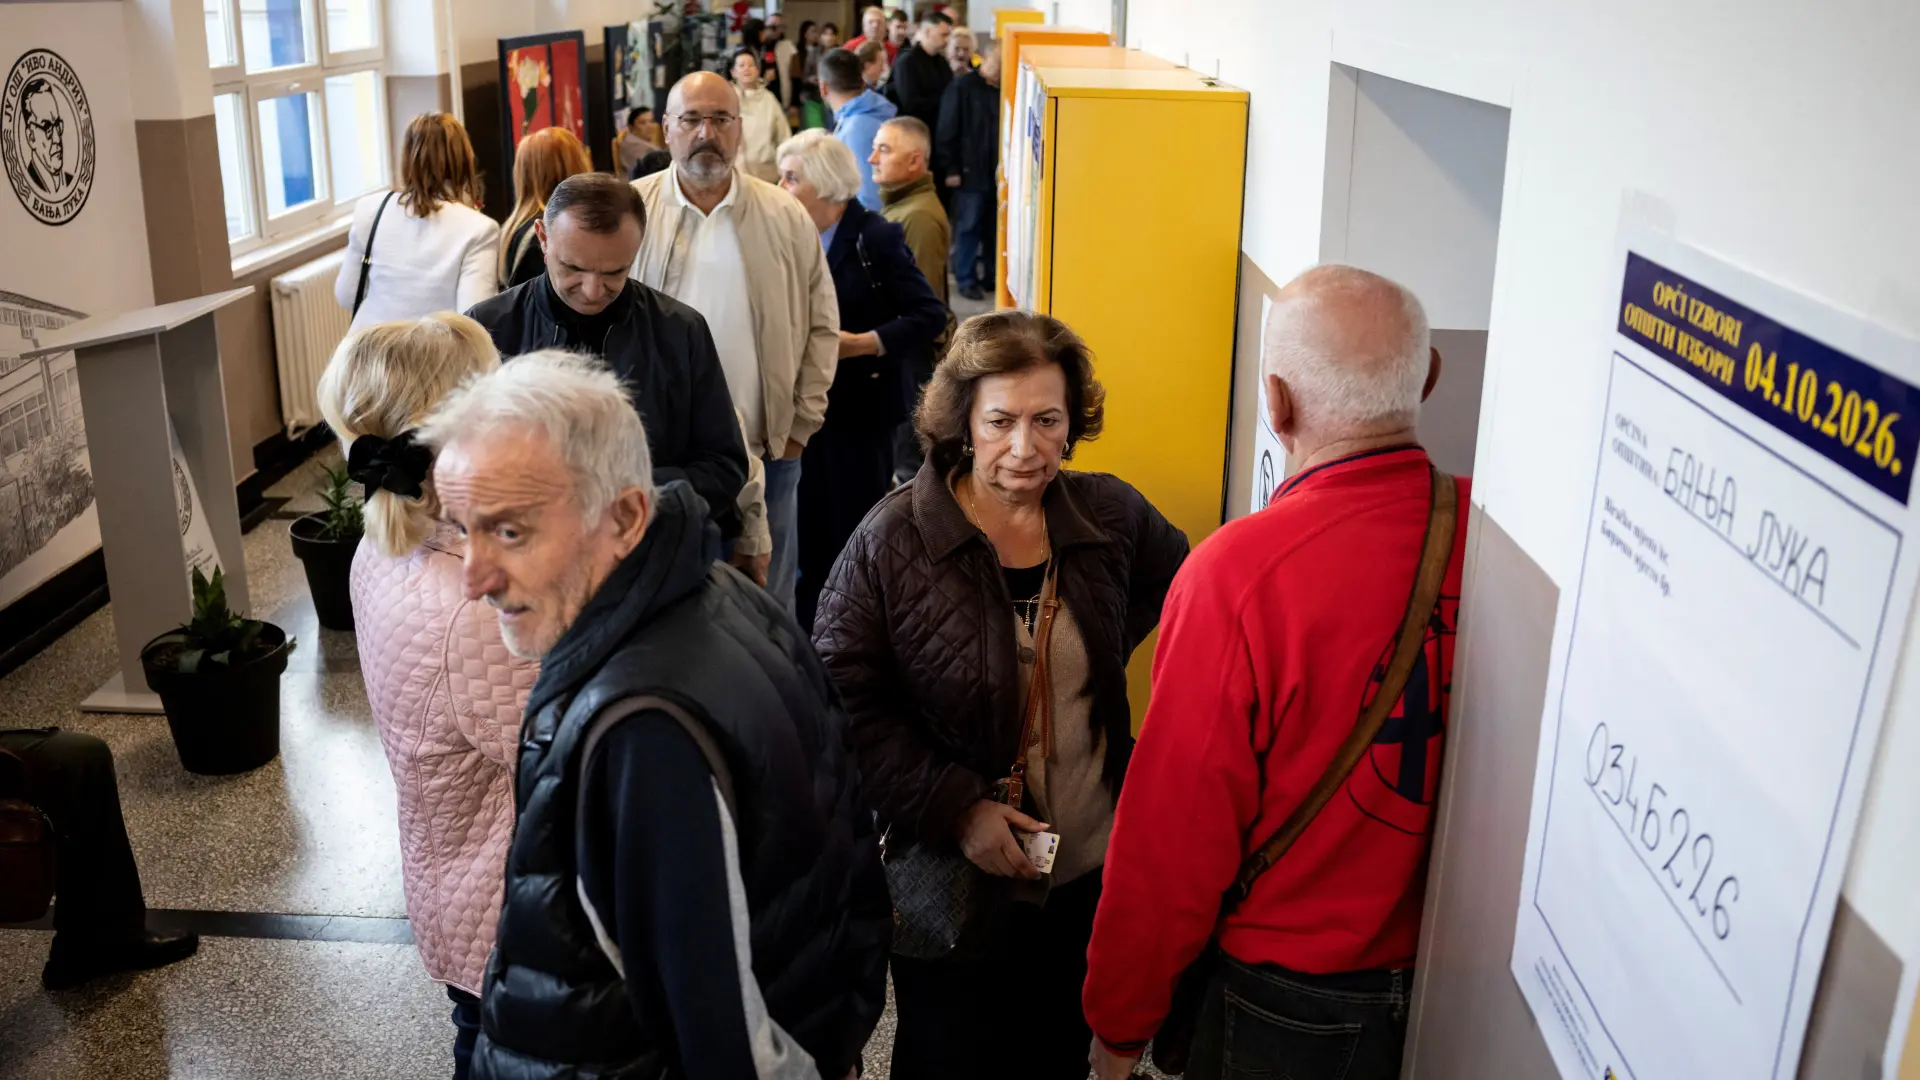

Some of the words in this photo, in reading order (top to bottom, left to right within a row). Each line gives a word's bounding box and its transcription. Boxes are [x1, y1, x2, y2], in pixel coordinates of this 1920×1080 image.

[4, 102, 14, 123] ЈУ
[9, 69, 24, 98] ОШ
[32, 197, 61, 219] БАЊА
[63, 187, 84, 216] ЛУКА
[1624, 302, 1676, 351] ОПШТИ
[1676, 330, 1735, 386] ИЗБОРИ
[1652, 281, 1688, 319] OPĆI
[1687, 297, 1743, 348] IZBORI
[1744, 341, 1902, 476] 04.10.2026.
[1663, 446, 1737, 537] БАЊА
[1746, 509, 1829, 607] ЛУКА
